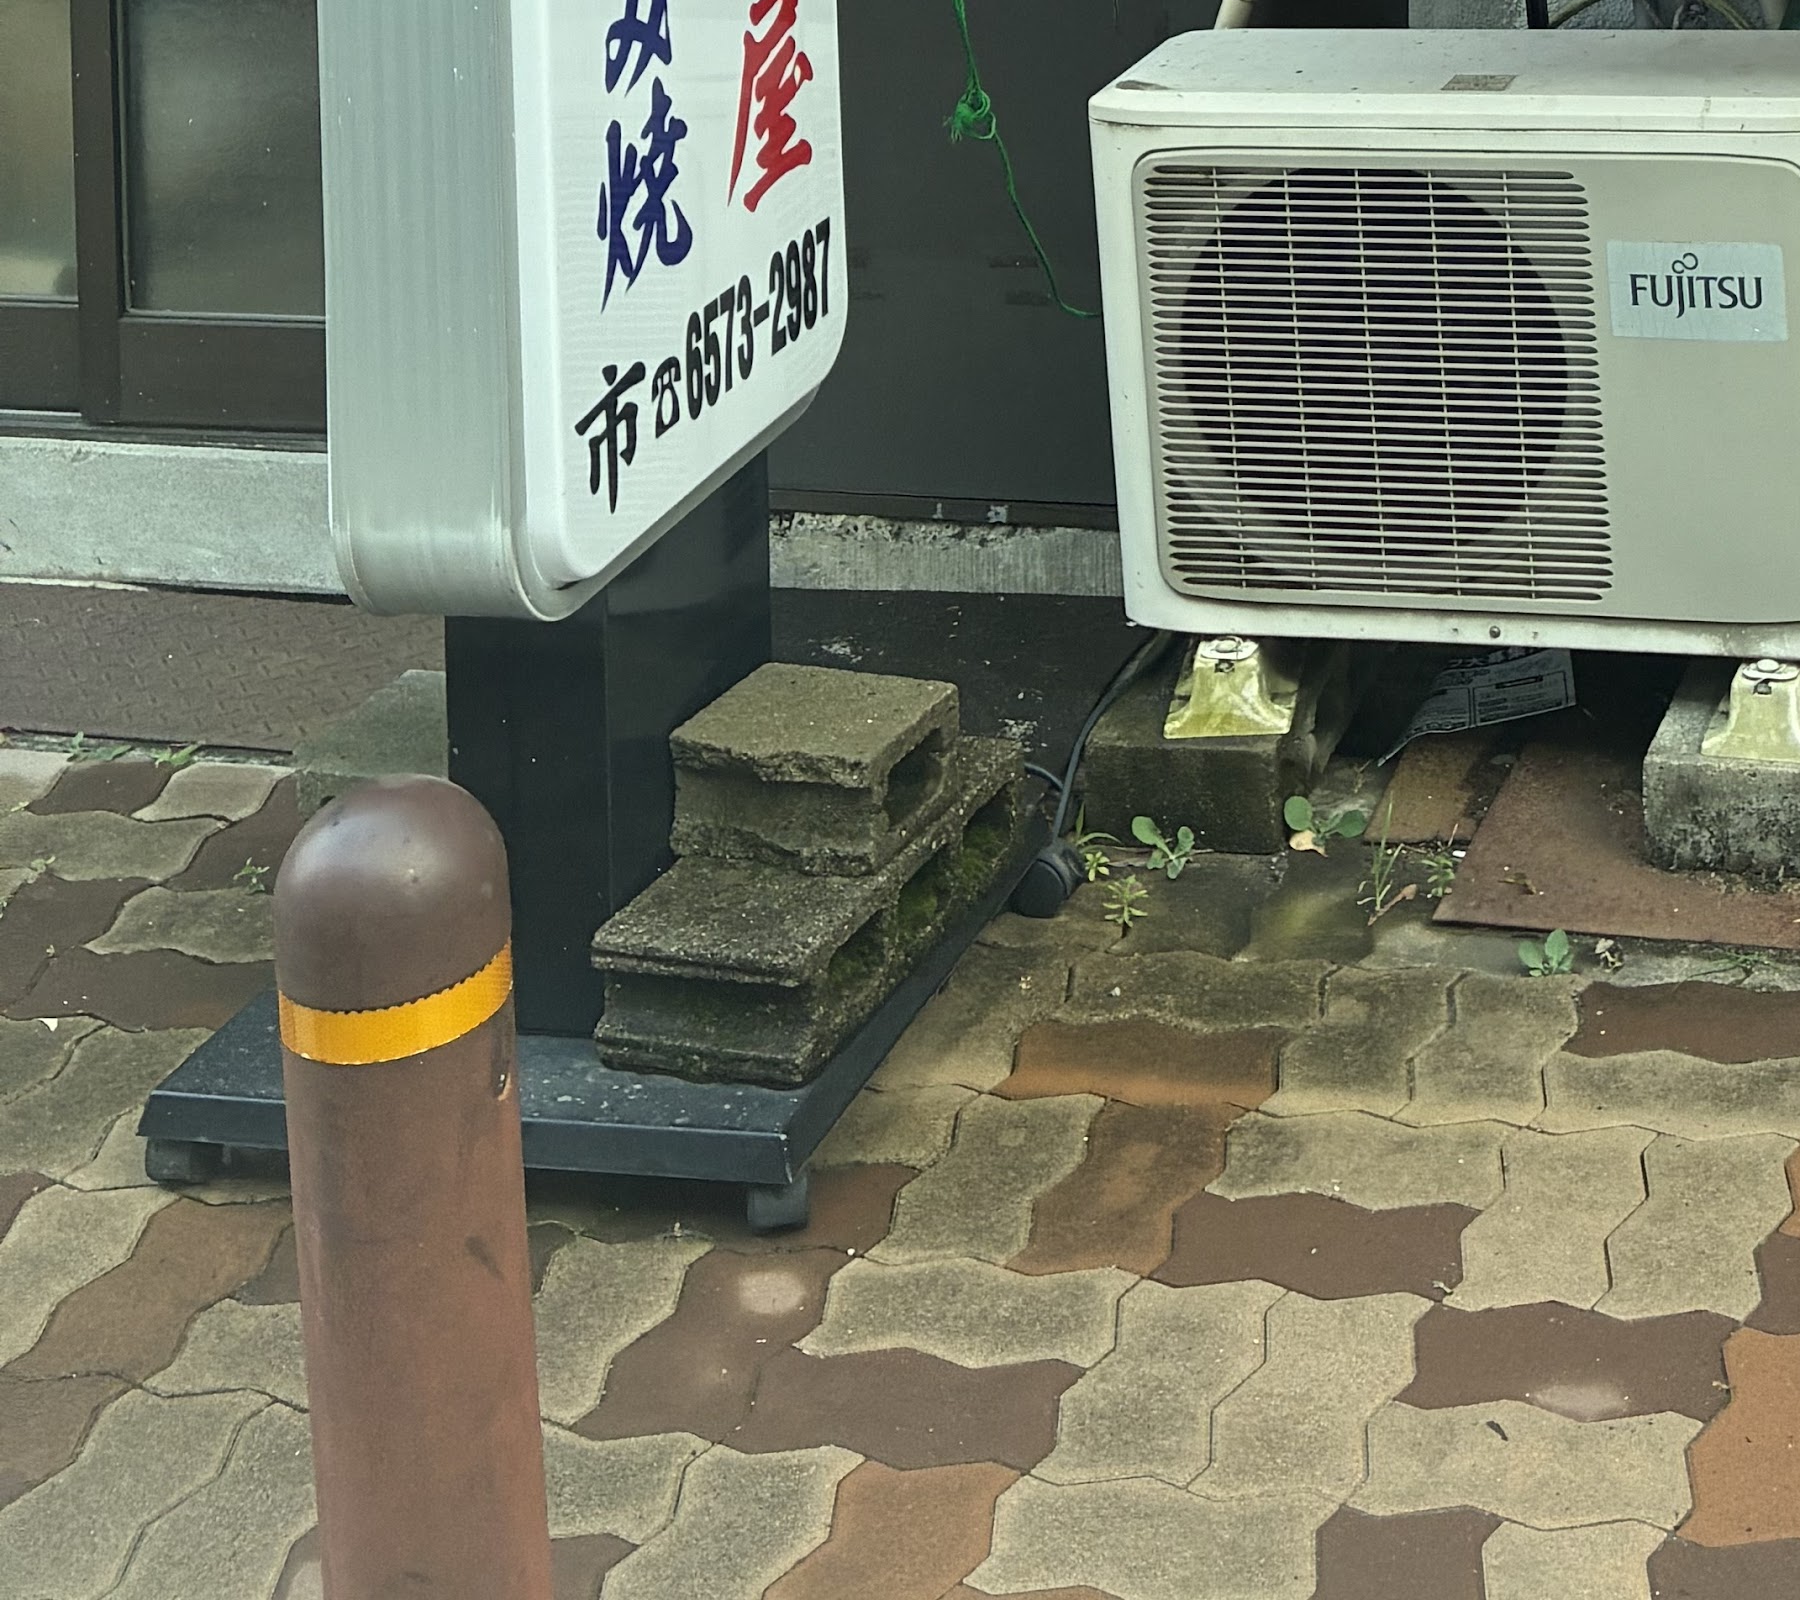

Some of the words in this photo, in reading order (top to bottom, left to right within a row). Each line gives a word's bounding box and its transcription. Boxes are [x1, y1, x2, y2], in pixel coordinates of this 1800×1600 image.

[576, 363, 646, 513] 市
[686, 219, 831, 421] 6573-2987
[1629, 252, 1763, 318] FUJITSU
